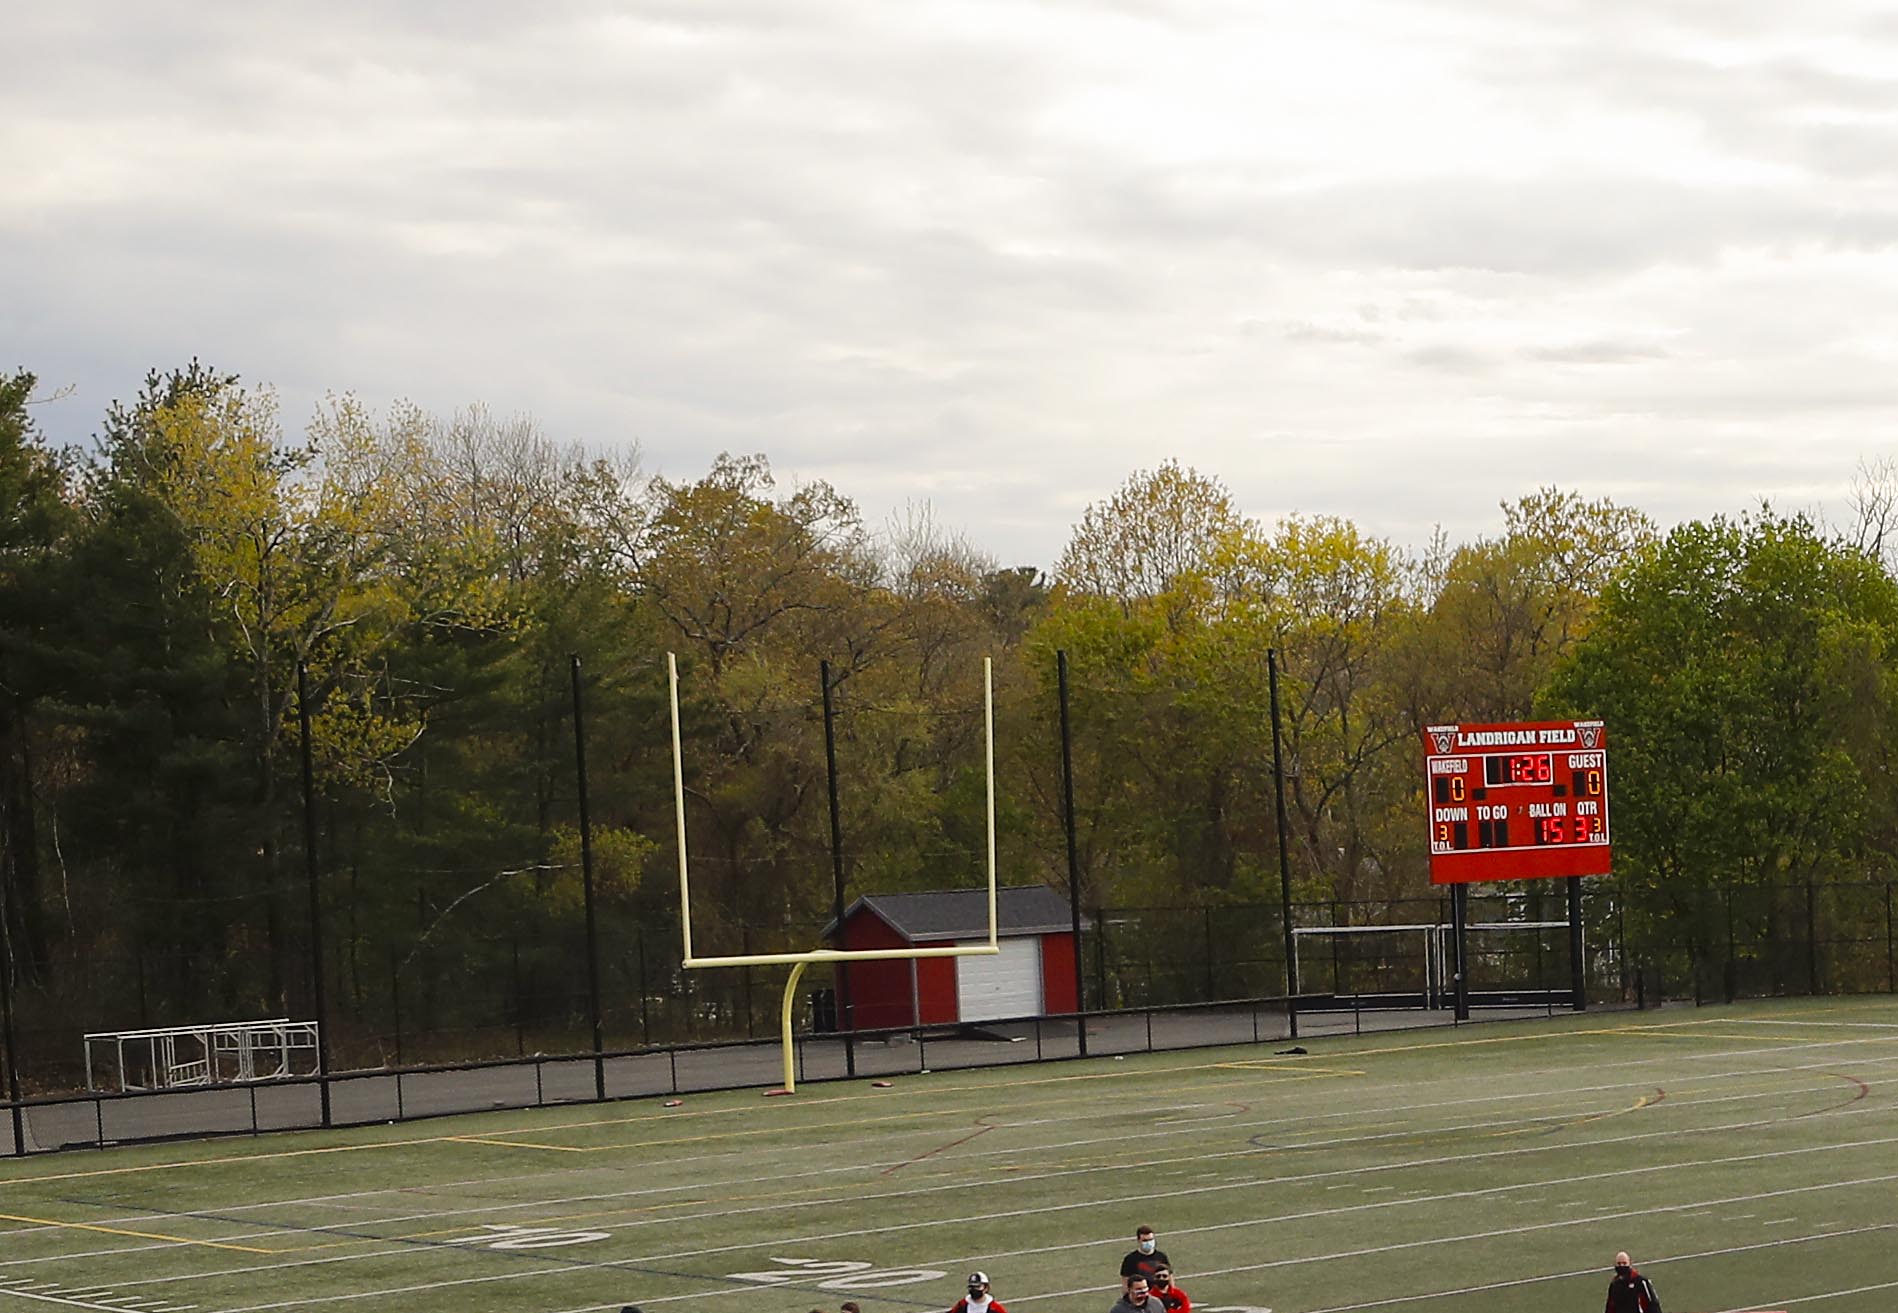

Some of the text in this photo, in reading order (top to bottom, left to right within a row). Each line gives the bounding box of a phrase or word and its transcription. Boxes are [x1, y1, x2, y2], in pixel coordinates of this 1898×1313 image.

[1458, 729, 1576, 746] LANDRIGAN FIELD
[1511, 755, 1549, 781] 1:26
[1568, 754, 1602, 769] GUEST
[1452, 777, 1465, 801] 0
[1588, 771, 1600, 795] 0
[1436, 807, 1468, 822] DOWN
[1476, 805, 1507, 820] TO GO
[1529, 803, 1567, 818] BALL ON
[1577, 801, 1597, 815] QTR
[1542, 817, 1563, 842] 15
[1576, 816, 1587, 842] 3
[1594, 817, 1601, 832] 3
[1440, 825, 1448, 841] 3
[725, 1260, 949, 1289] 20
